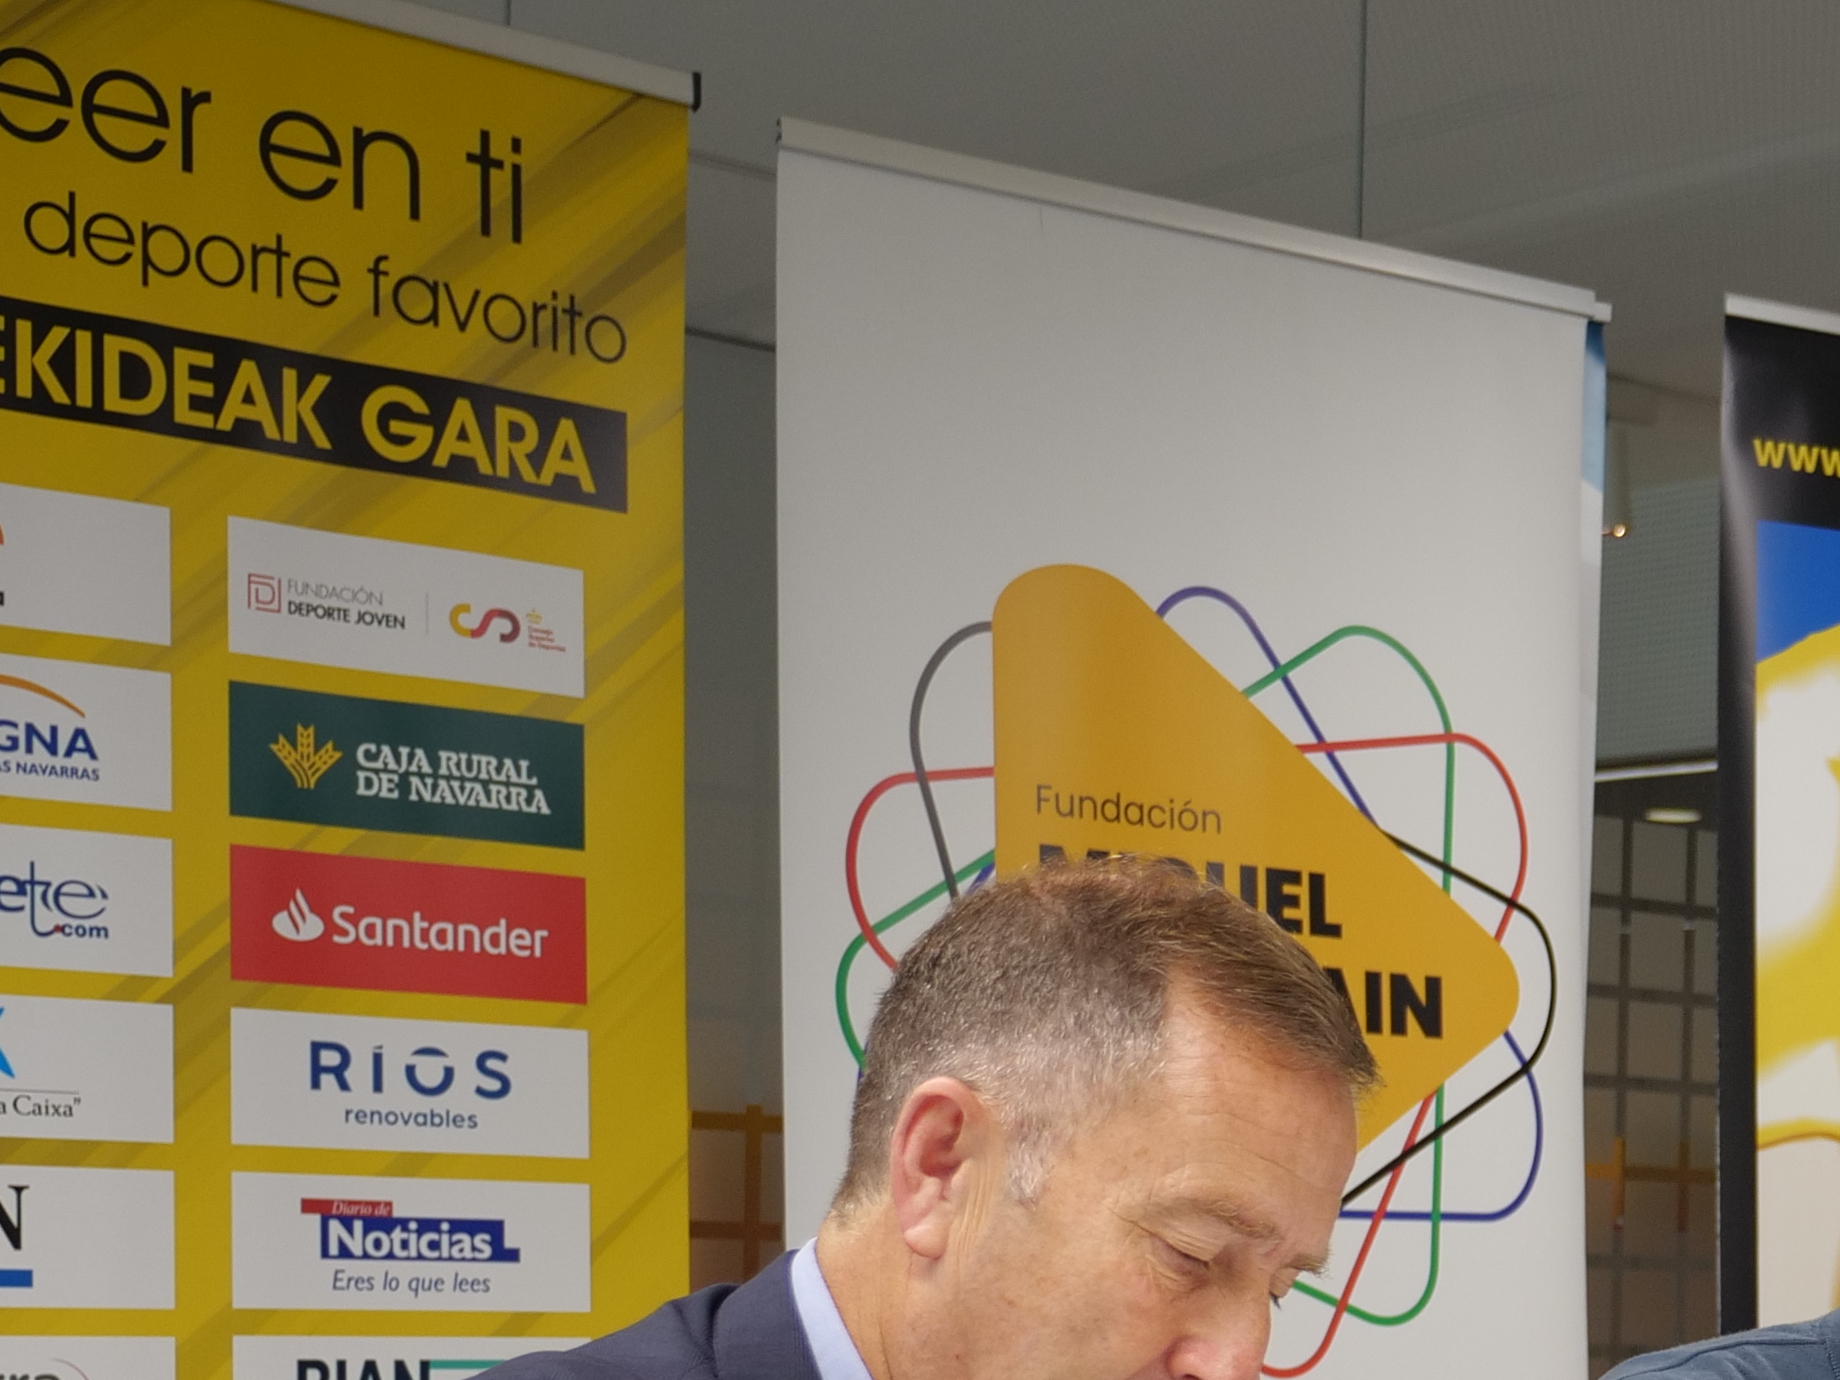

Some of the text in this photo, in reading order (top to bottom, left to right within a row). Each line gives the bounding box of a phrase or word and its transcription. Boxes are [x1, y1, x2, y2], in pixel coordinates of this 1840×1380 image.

[259, 110, 421, 221] en
[466, 129, 523, 244] ti
[23, 190, 628, 365] deporte favorito
[0, 316, 597, 496] KIDEAK GARA
[287, 578, 384, 607] FUNDACIÓN
[287, 600, 406, 630] DEPORTE JOVEN
[0, 719, 99, 762] GNA
[16, 762, 100, 782] NAVARRAS
[356, 743, 537, 786] CAJA RURAL
[356, 771, 551, 815] DE NAVARRA
[1035, 784, 1222, 834] Fundación
[332, 905, 549, 958] Santander
[309, 1040, 512, 1100] RÍOS
[344, 1106, 479, 1129] renovables
[332, 1201, 390, 1217] Diario de
[327, 1218, 493, 1260] Noticias
[332, 1269, 491, 1299] Eres lo que lees
